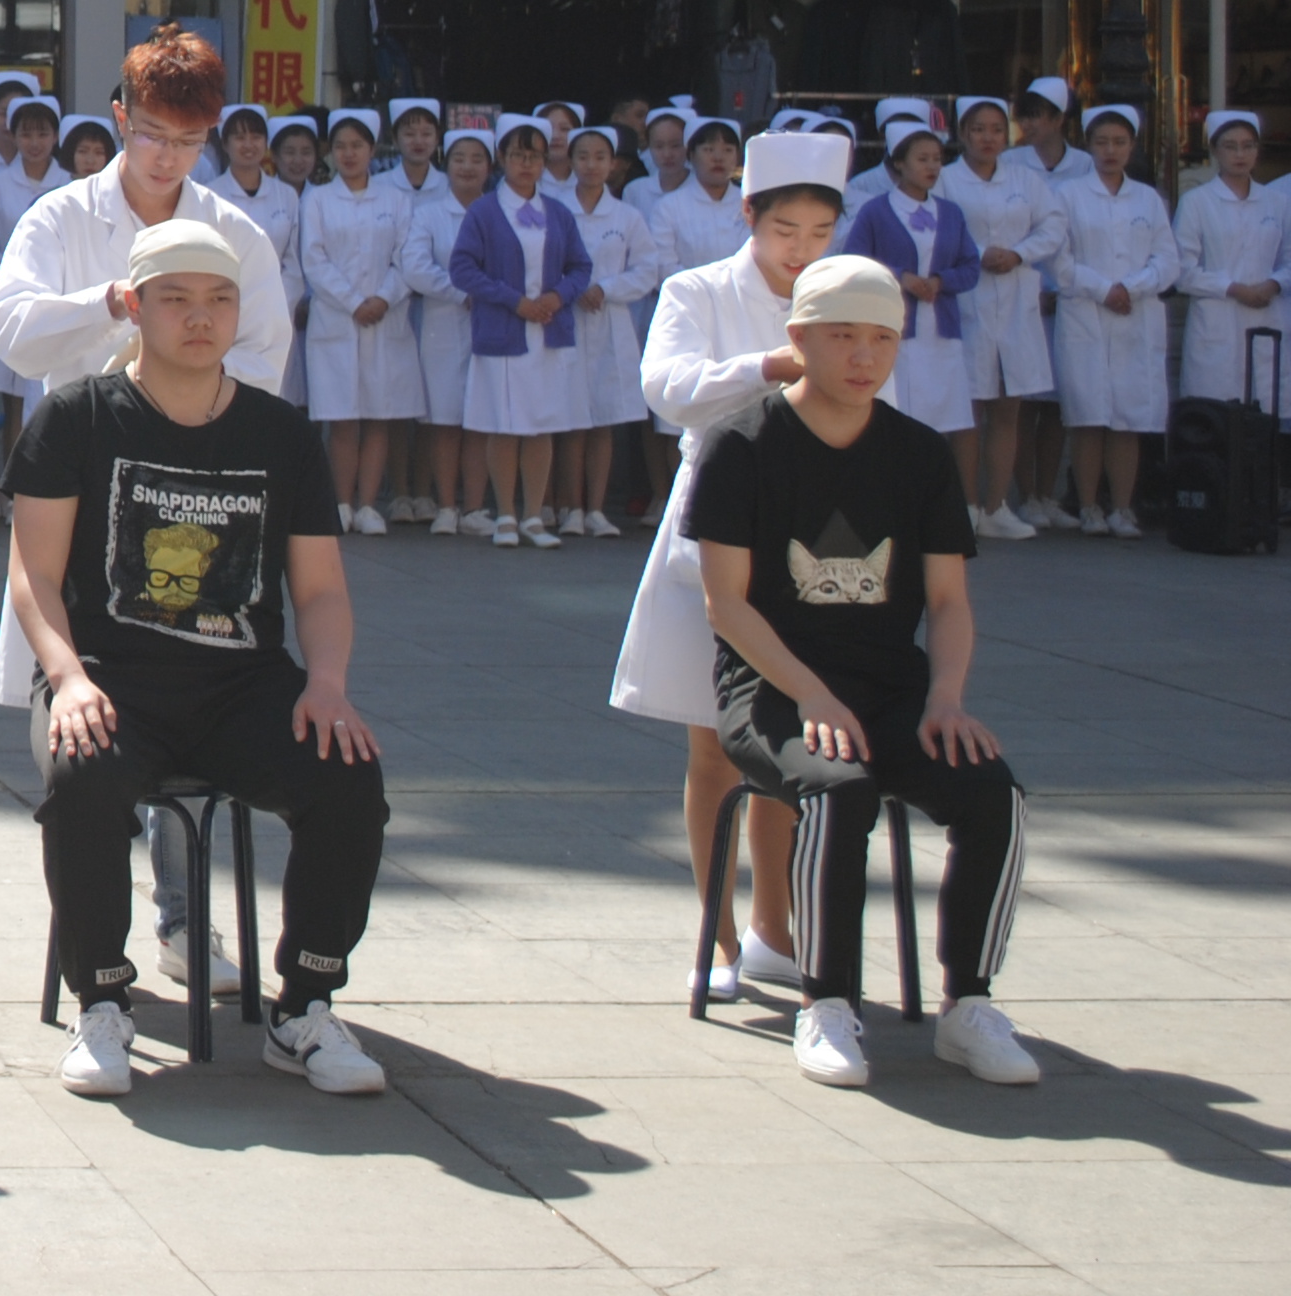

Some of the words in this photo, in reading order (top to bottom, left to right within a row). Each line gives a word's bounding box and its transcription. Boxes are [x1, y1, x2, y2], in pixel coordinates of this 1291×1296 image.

[131, 484, 262, 514] SNAPDRAGON
[158, 507, 229, 526] CLOTHING
[300, 953, 341, 971] TRUE
[100, 964, 133, 983] TRUE
